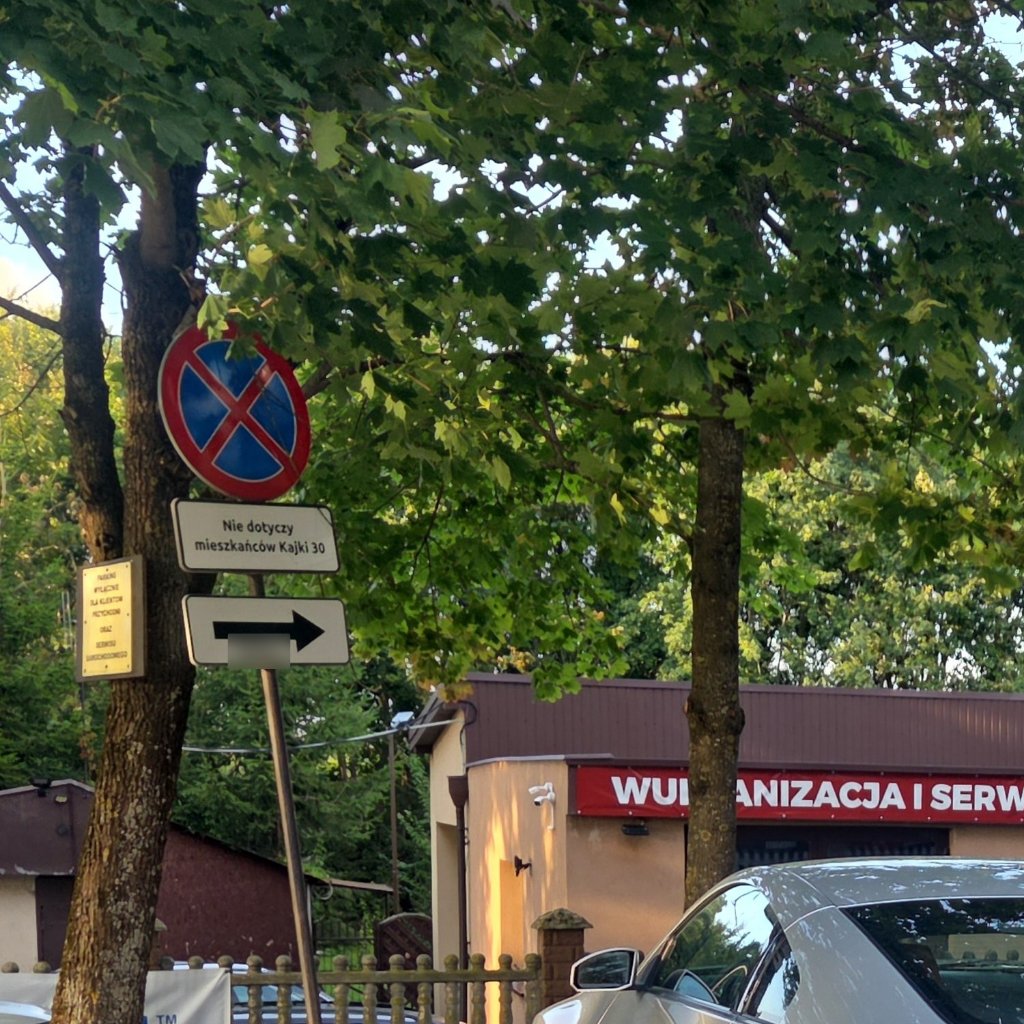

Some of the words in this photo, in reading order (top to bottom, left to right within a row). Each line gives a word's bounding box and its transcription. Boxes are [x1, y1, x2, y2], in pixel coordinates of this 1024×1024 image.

[223, 519, 244, 532] Nie
[247, 520, 294, 536] dotyczy
[195, 538, 276, 553] mieszkańców
[279, 541, 309, 555] Kajki
[312, 542, 326, 554] 30
[611, 776, 906, 810] WULANIZACJA
[914, 783, 923, 810] I
[156, 1014, 177, 1024] TM
